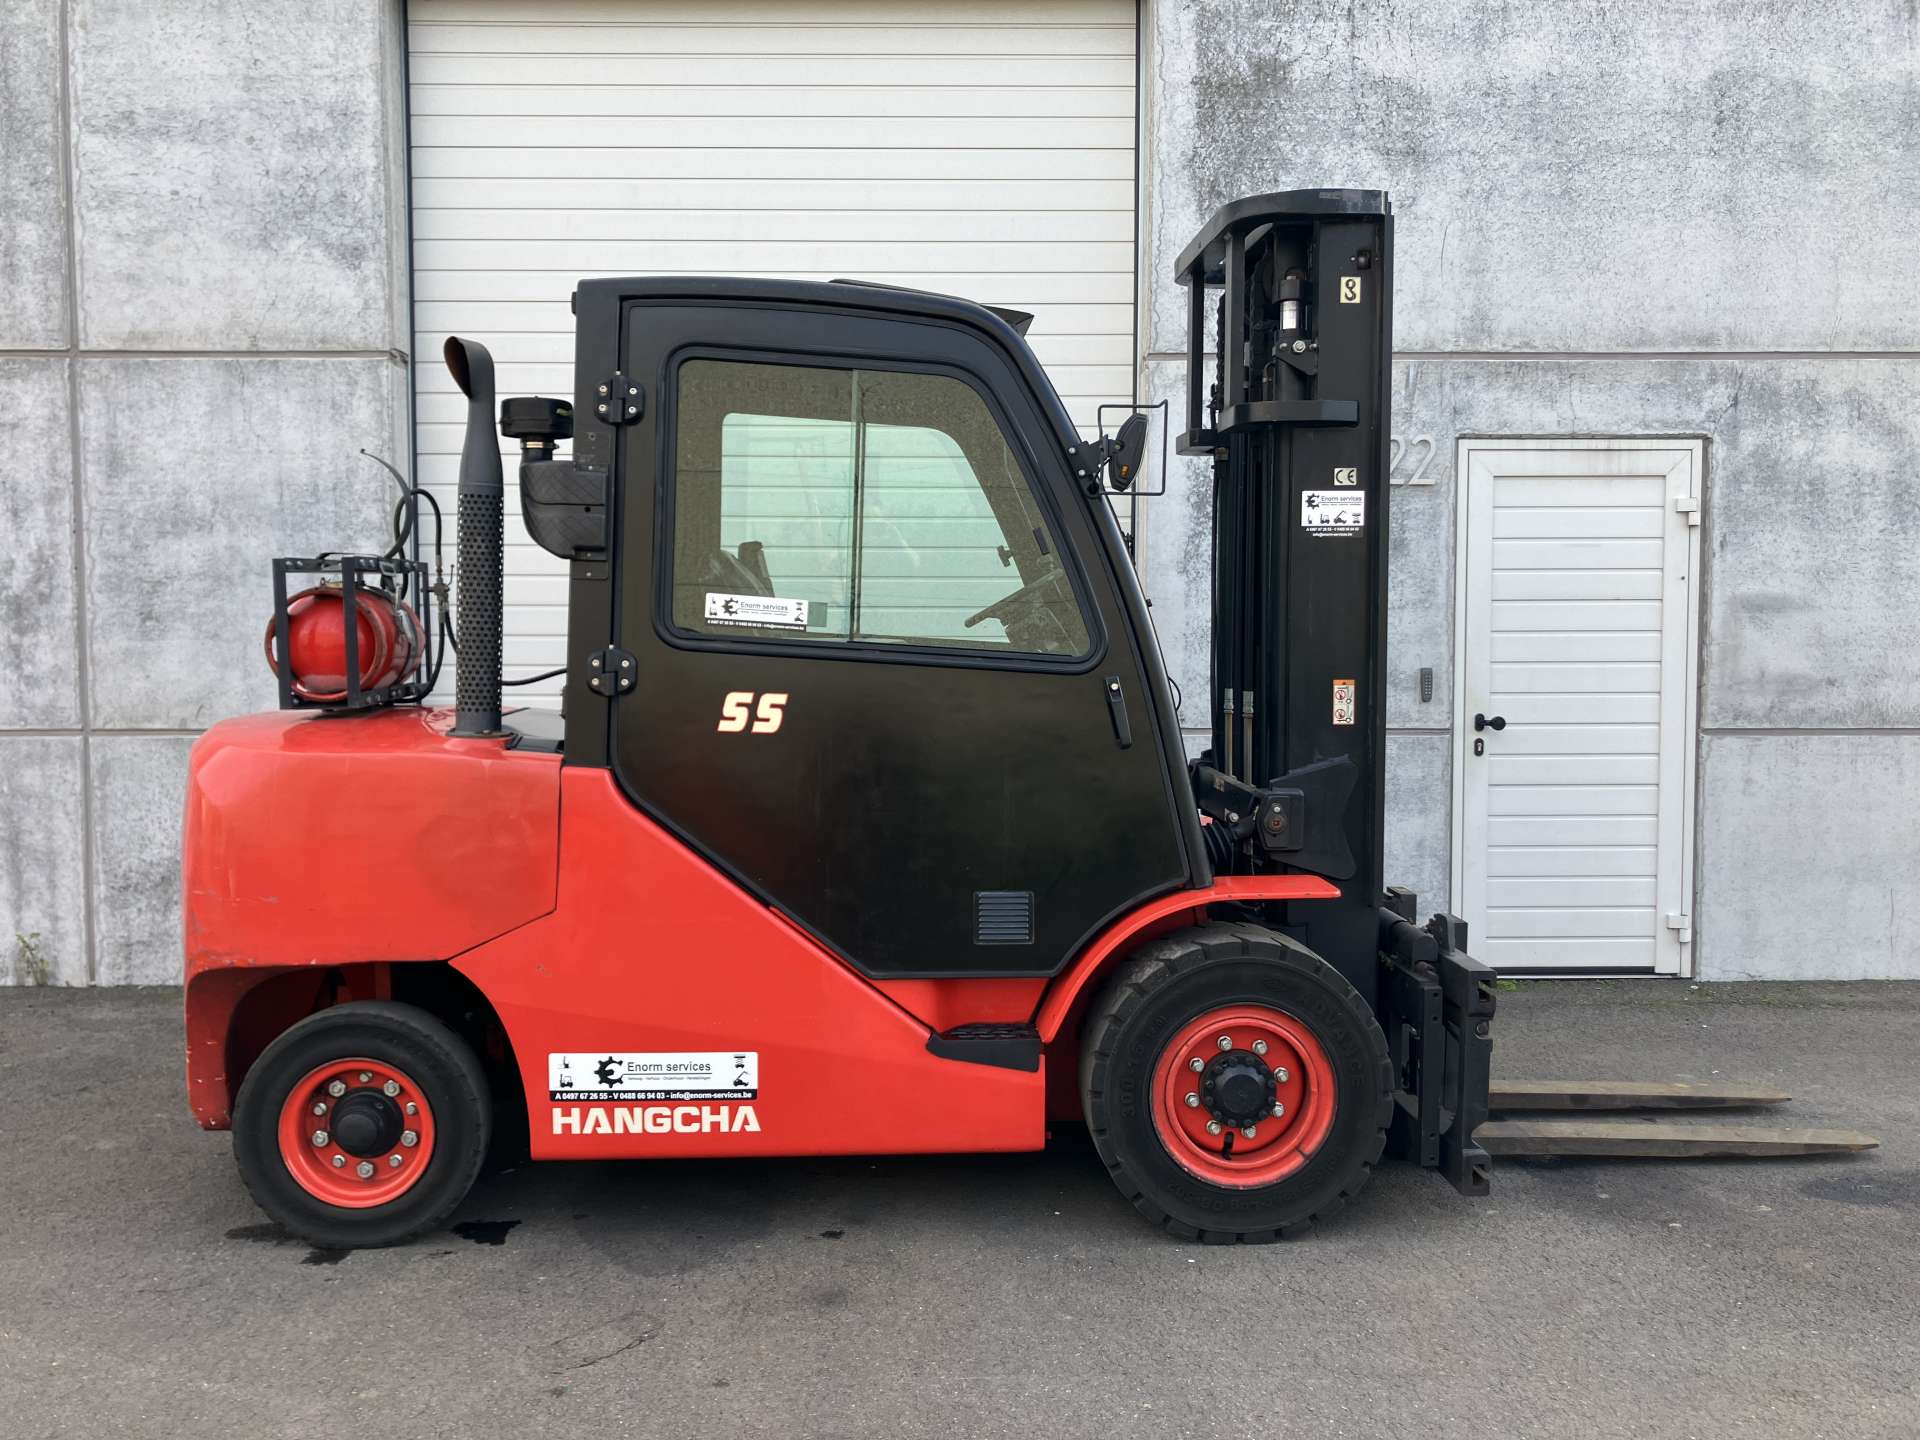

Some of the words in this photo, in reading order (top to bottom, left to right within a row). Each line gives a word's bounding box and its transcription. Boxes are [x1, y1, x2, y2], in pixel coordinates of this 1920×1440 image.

[740, 601, 761, 609] Enorm
[627, 1061, 662, 1072] Enorm
[666, 1061, 711, 1072] services
[670, 1092, 752, 1100] info@enorm-services.be
[552, 1106, 761, 1134] HANGCHA
